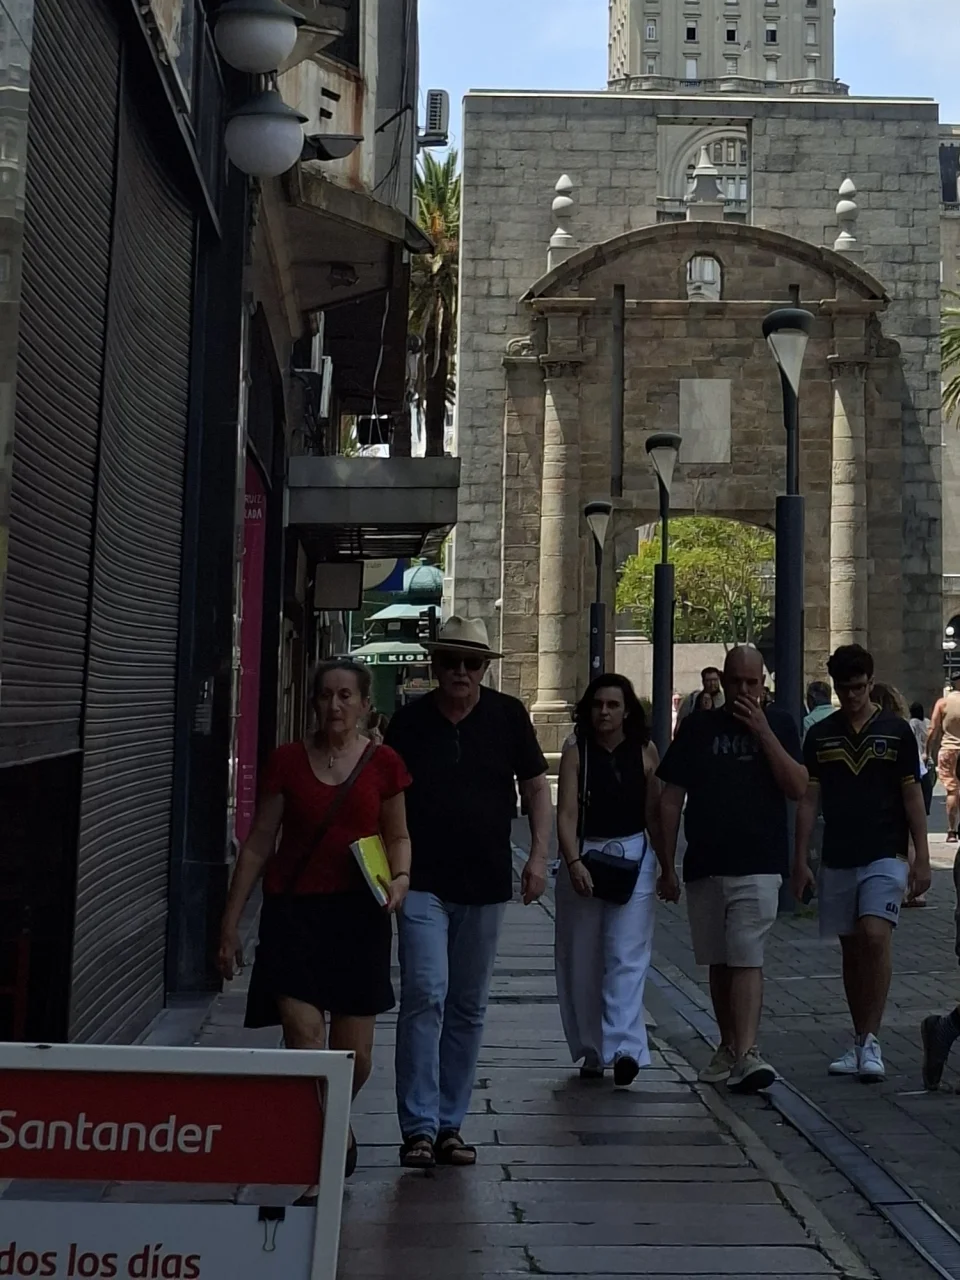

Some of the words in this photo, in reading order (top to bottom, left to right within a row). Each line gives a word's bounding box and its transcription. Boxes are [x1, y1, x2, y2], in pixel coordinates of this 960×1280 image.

[0, 1110, 222, 1153] Santander
[67, 1243, 118, 1277] los
[127, 1243, 201, 1279] días
